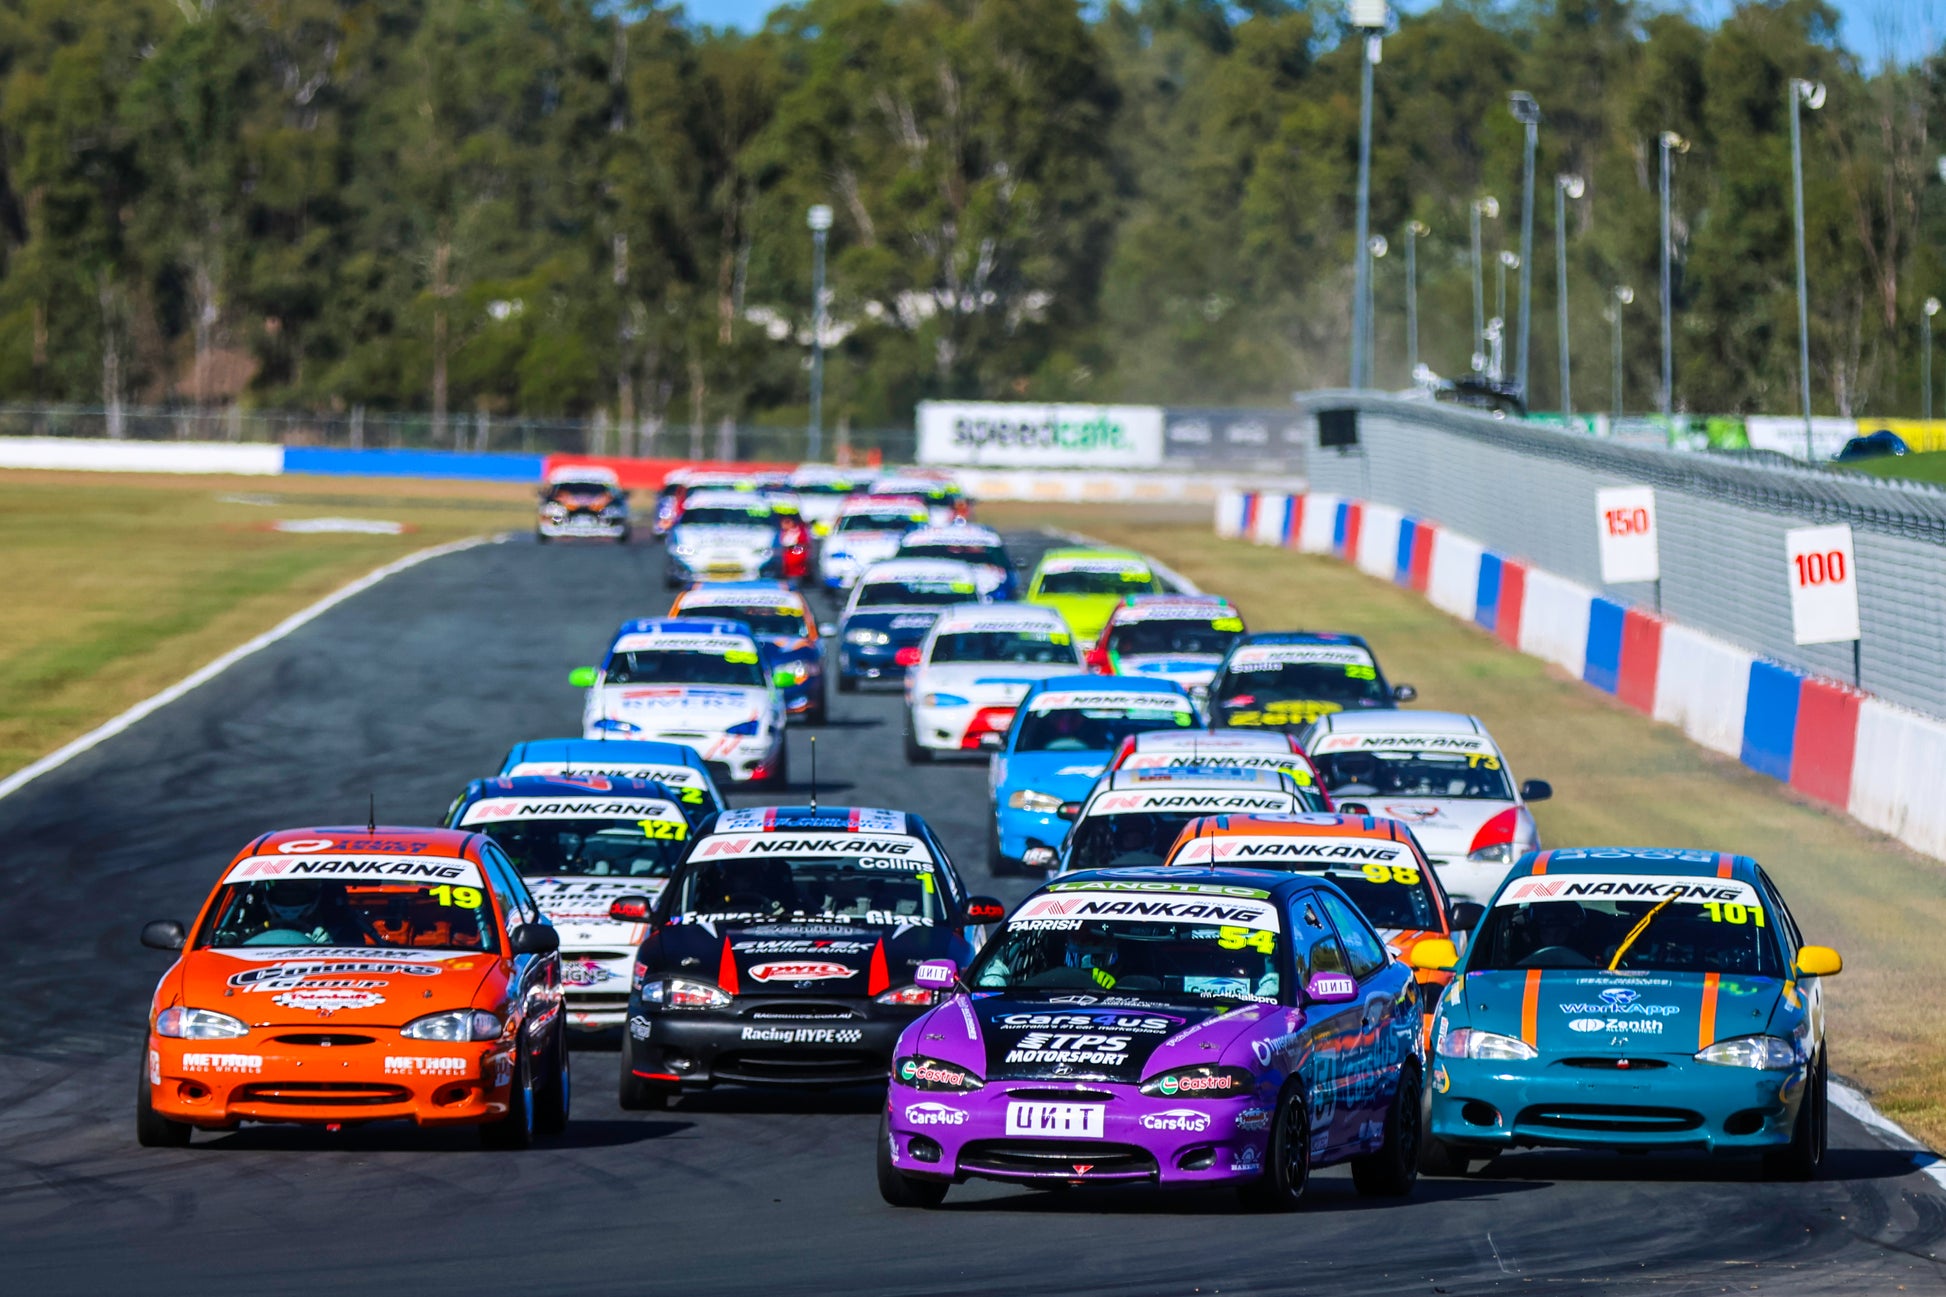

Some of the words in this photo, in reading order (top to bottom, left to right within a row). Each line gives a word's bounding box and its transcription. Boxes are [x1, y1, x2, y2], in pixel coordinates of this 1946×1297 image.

[1605, 507, 1650, 536] 150
[1794, 550, 1846, 588] 100
[1361, 736, 1483, 749] NANKANG
[1465, 753, 1500, 771] 73
[681, 787, 704, 804] 2
[1143, 796, 1288, 810] NANKANG
[518, 803, 668, 816] NANKANG
[637, 819, 689, 841] 127
[750, 840, 915, 855] NANKANG
[1236, 844, 1401, 861] NANKANG
[289, 861, 466, 879] NANKANG
[858, 857, 935, 873] Collins
[915, 872, 934, 893] 1
[1361, 863, 1420, 886] 98
[429, 884, 483, 909] 19
[1055, 882, 1255, 896] LANOTEC
[1563, 882, 1743, 900] NANKANG
[865, 910, 934, 927] Glass
[1075, 901, 1265, 922] NANKANG
[1703, 901, 1766, 928] 101
[1008, 919, 1084, 932] PARRISH
[1217, 925, 1275, 955] 54
[1560, 1003, 1680, 1015] WorkApp
[1098, 1025, 1167, 1035] marketplace
[1606, 1018, 1663, 1030] Zenith
[1050, 1033, 1133, 1052] TPS
[182, 1053, 263, 1068] METHOD
[384, 1056, 467, 1070] METHOD
[1005, 1050, 1129, 1065] MOTORSPORT
[215, 1066, 262, 1074] WHEELS
[420, 1069, 467, 1077] WHEELS
[915, 1067, 965, 1086] Castrol
[1179, 1075, 1232, 1090] Castrol
